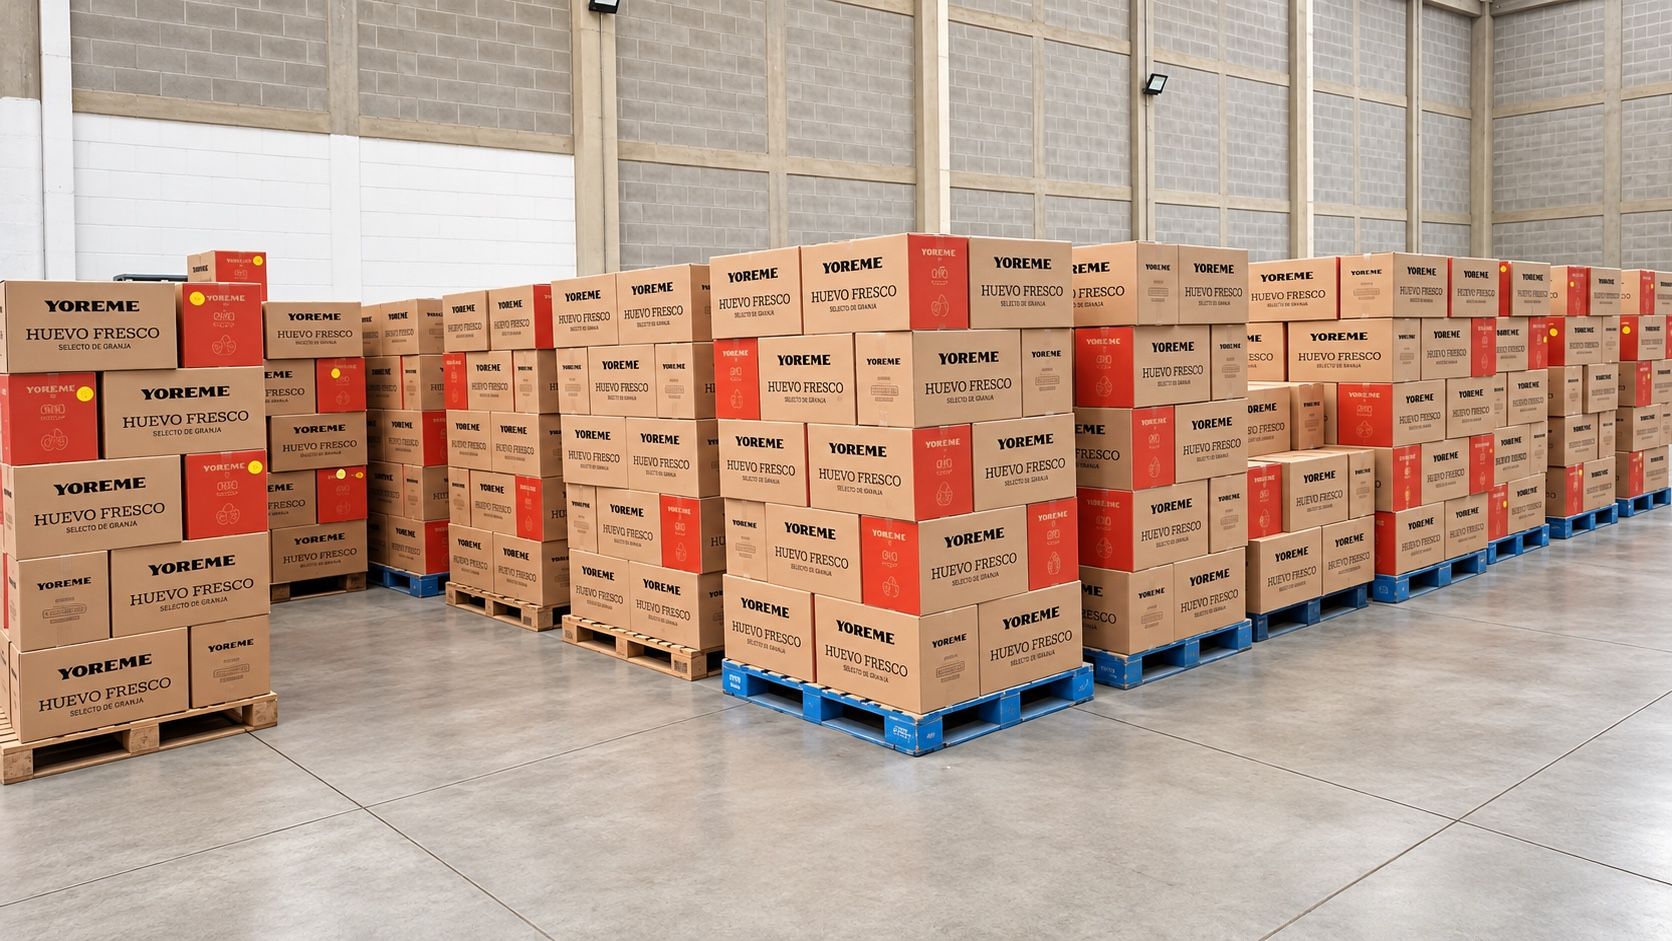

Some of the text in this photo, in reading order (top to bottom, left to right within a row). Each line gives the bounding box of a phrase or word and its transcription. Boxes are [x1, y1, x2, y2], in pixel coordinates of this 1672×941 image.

[823, 257, 882, 274] YOREME
[994, 257, 1051, 269] YOREME
[1194, 263, 1234, 274] YOREME
[728, 268, 778, 282] YOREME
[1261, 272, 1313, 282] YOREME
[1408, 266, 1436, 276] YOREME
[632, 282, 673, 295] YOREME
[812, 285, 896, 303] HUEVO FRESCO
[982, 285, 1063, 296] HUEVO FRESCO
[1078, 286, 1124, 298] FRESCO
[1185, 287, 1242, 297] HUEVO FRESCO
[565, 290, 601, 302] YOREME
[720, 294, 790, 309] HUEVO FRESCO
[1252, 290, 1325, 301] HUEVO FRESCO
[45, 300, 139, 312] YOREME
[624, 305, 683, 319] HUEVO FRESCO
[559, 312, 610, 324] HUEVO FRESCO
[26, 328, 159, 340] HUEVO FRESCO
[1310, 332, 1368, 341] YOREME
[1434, 330, 1460, 338] YOREME
[1152, 342, 1194, 352] YOREME
[778, 355, 830, 365] YOREME
[938, 351, 999, 364] YOREME
[1299, 352, 1381, 361] HUEVO FRESCO
[602, 360, 639, 370] YOREME
[1143, 365, 1203, 378] HUEVO FRESCO
[27, 385, 74, 393] YOREME
[266, 388, 305, 397] FRESCO
[596, 382, 648, 392] HUEVO FRESCO
[768, 382, 843, 393] HUEVO FRESCO
[926, 378, 1012, 394] HUEVO FRESCO
[141, 386, 230, 400] YOREME
[1406, 393, 1433, 403] YOREME
[123, 411, 248, 428] HUEVO FRESCO
[1192, 417, 1232, 430] YOREME
[294, 424, 345, 434] YOREME
[500, 425, 527, 434] YOREME
[1260, 422, 1285, 433] FRESCO
[575, 430, 610, 440] YOREME
[641, 433, 680, 445] YOREME
[283, 440, 357, 452] HUEVO FRESCO
[736, 436, 784, 449] YOREME
[926, 438, 960, 448] YOREME
[998, 434, 1053, 450] YOREME
[1184, 438, 1241, 455] HUEVO FRESCO
[568, 450, 620, 463] HUEVO FRESCO
[829, 443, 886, 457] YOREME
[634, 456, 690, 470] HUEVO FRESCO
[727, 460, 795, 476] HUEVO FRESCO
[986, 458, 1065, 480] HUEVO FRESCO
[819, 468, 901, 487] HUEVO FRESCO
[1304, 470, 1335, 483] YOREME
[54, 477, 146, 496] YOREME
[610, 504, 644, 517] YOREME
[1151, 498, 1192, 514] YOREME
[34, 503, 165, 527] HUEVO FRESCO
[1038, 511, 1067, 522] YOREME
[66, 525, 96, 534] SELECTO
[732, 520, 756, 528] YOREME
[785, 522, 836, 540] YOREME
[1141, 520, 1201, 542] HUEVO FRESCO
[294, 533, 344, 545] YOREME
[944, 528, 1004, 548] YOREME
[284, 553, 318, 565] HUEVO
[320, 548, 357, 559] FRESCO
[775, 546, 807, 561] HUEVO
[809, 552, 848, 570] FRESCO
[1275, 546, 1308, 562] YOREME
[148, 555, 235, 576] YOREME
[932, 552, 1017, 580] HUEVO FRESCO
[582, 566, 614, 581] YOREME
[1190, 568, 1230, 586] YOREME
[37, 577, 91, 590] YOREME
[643, 579, 680, 596] YOREME
[130, 578, 254, 607] HUEVO FRESCO
[741, 598, 789, 618] YOREME
[1181, 589, 1238, 614] HUEVO FRESCO
[636, 599, 690, 622] HUEVO FRESCO
[1003, 606, 1059, 630] YOREME
[732, 621, 801, 648] HUEVO FRESCO
[836, 620, 894, 645] YOREME
[208, 639, 253, 652] YOREME
[932, 634, 966, 648] YOREME
[991, 630, 1072, 662] HUEVO FRESCO
[58, 654, 152, 680] YOREME
[826, 645, 908, 678] HUEVO FRESCO
[39, 677, 171, 713] HUEVO FRESCO
[70, 706, 102, 717] SELECTO
